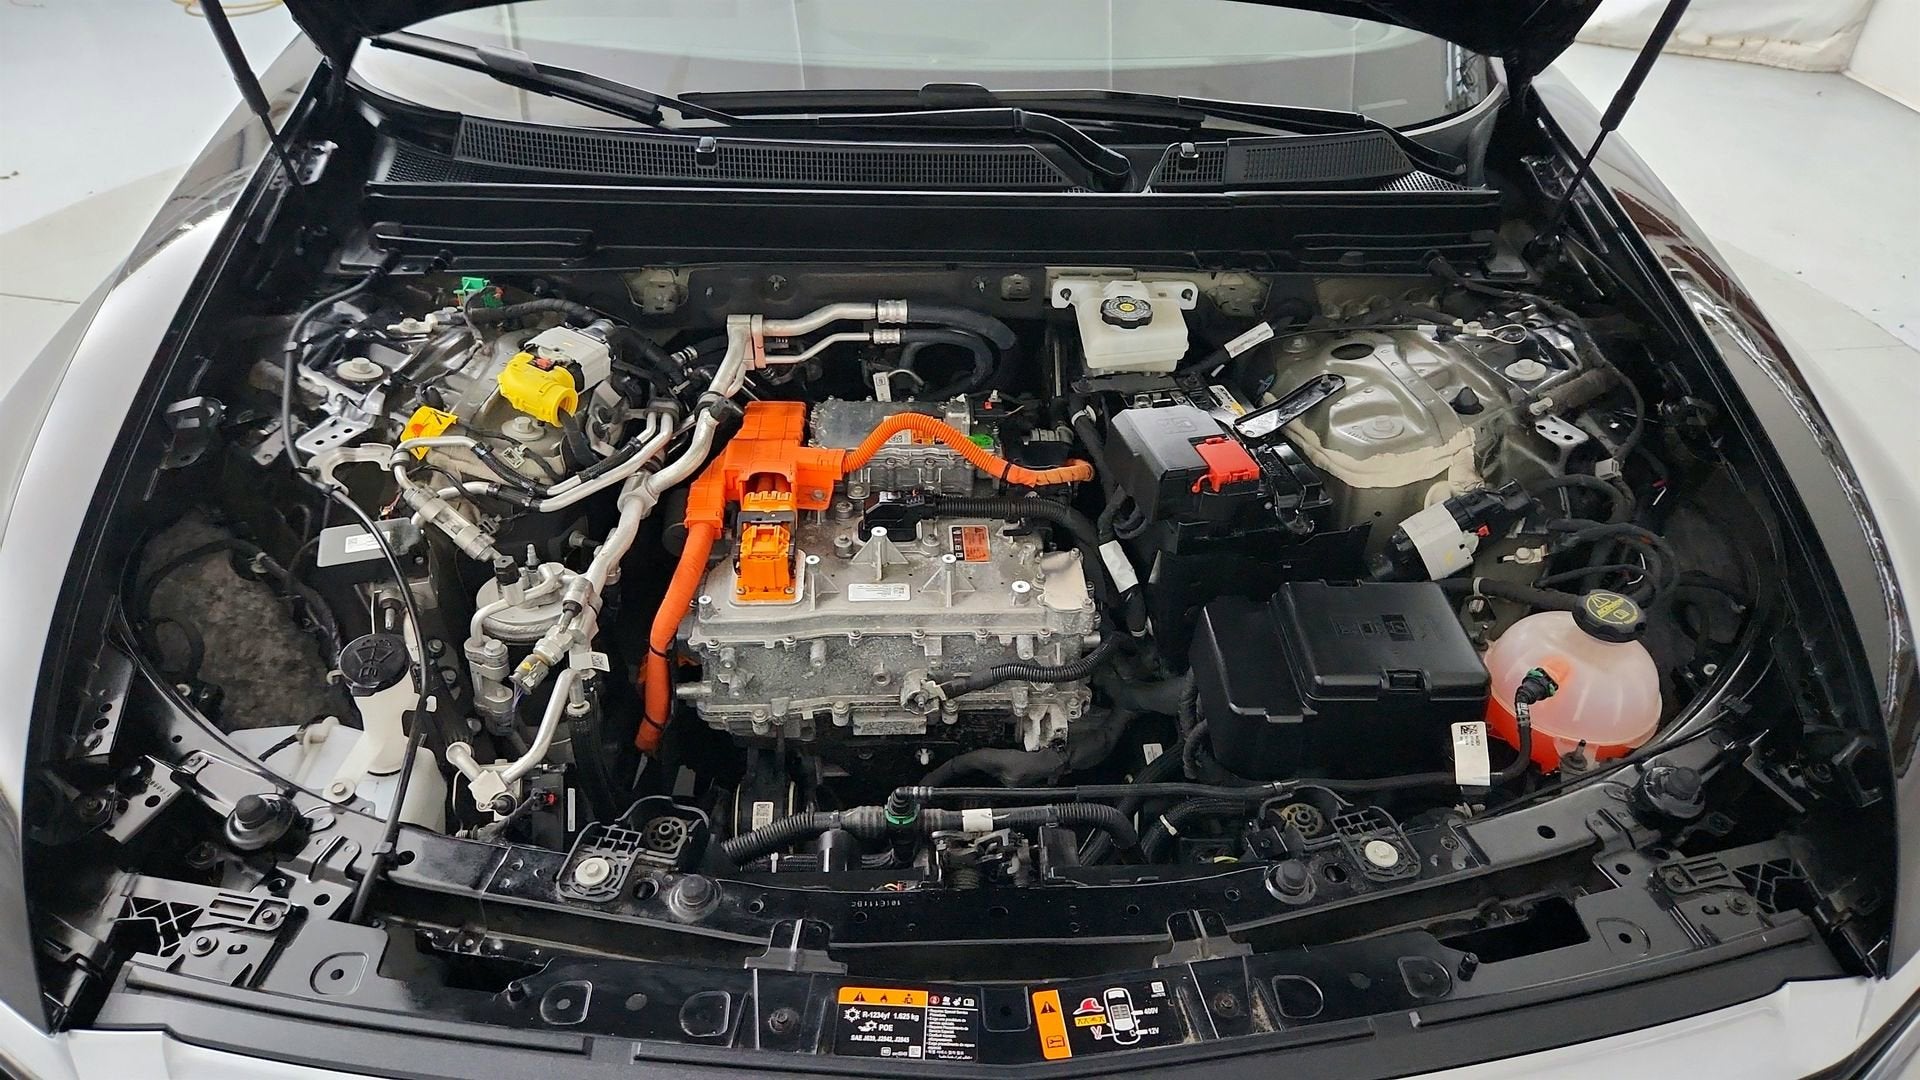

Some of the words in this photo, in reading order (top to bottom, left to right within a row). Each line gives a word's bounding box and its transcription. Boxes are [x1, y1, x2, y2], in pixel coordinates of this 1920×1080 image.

[862, 1010, 891, 1020] R-1234yf
[911, 1013, 920, 1022] kg
[878, 1023, 894, 1032] POE
